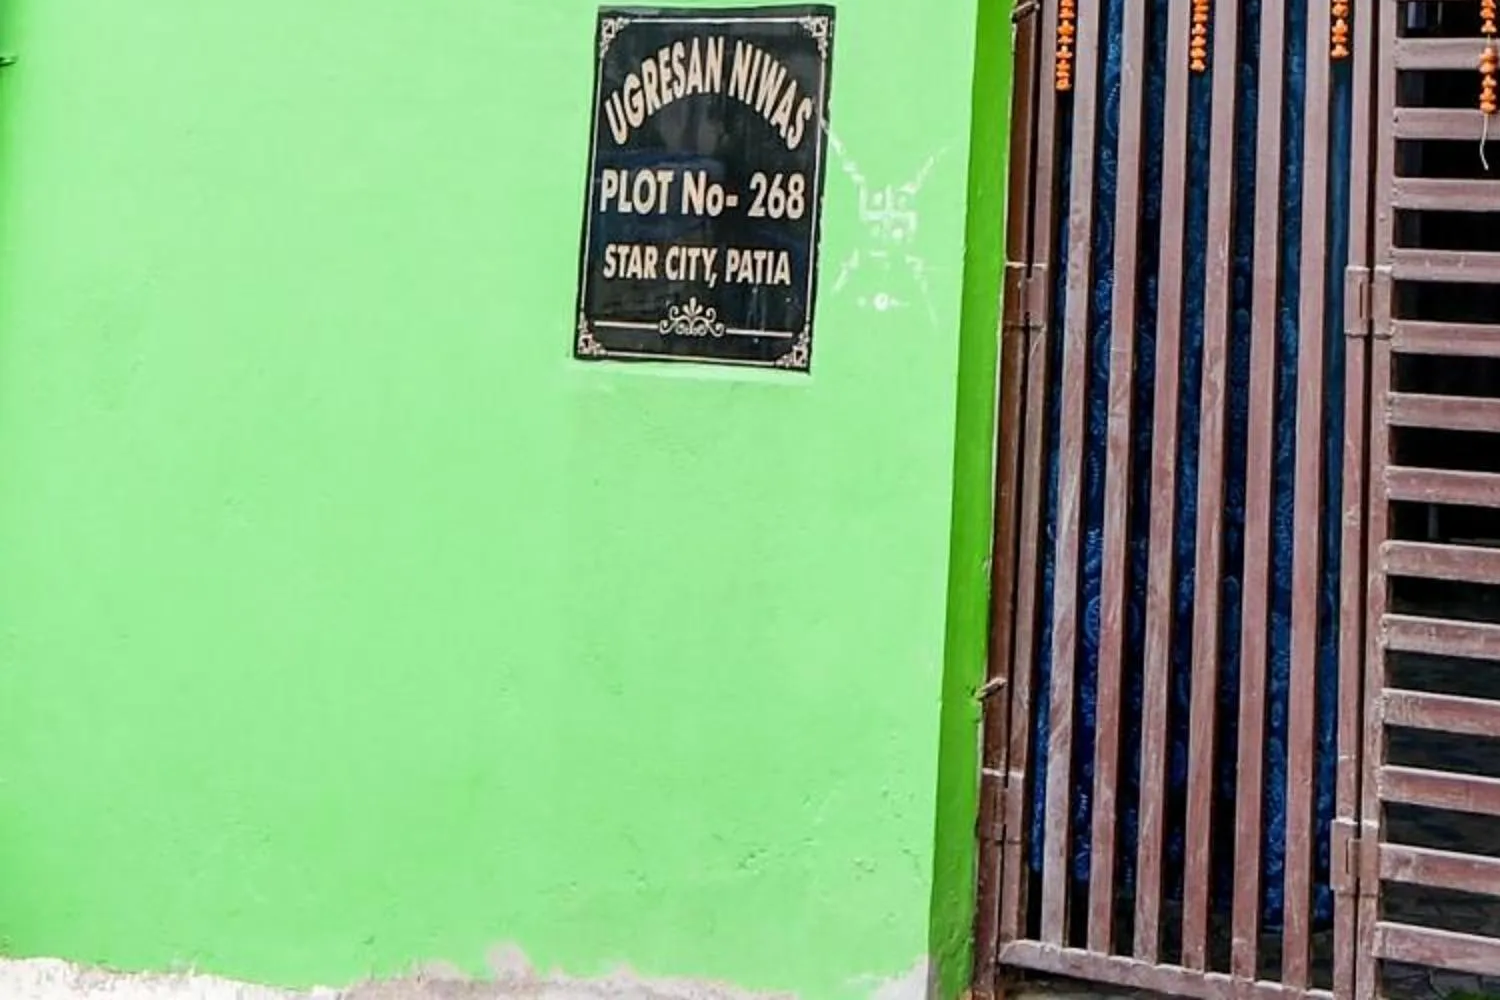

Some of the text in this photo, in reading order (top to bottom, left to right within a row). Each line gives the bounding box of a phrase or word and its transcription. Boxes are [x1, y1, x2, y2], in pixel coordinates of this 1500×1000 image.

[604, 36, 813, 151] UGRESAN NIWAS
[600, 168, 674, 215] PLOT
[748, 172, 805, 219] 268
[602, 244, 791, 288] STAR CITY, PATIA
